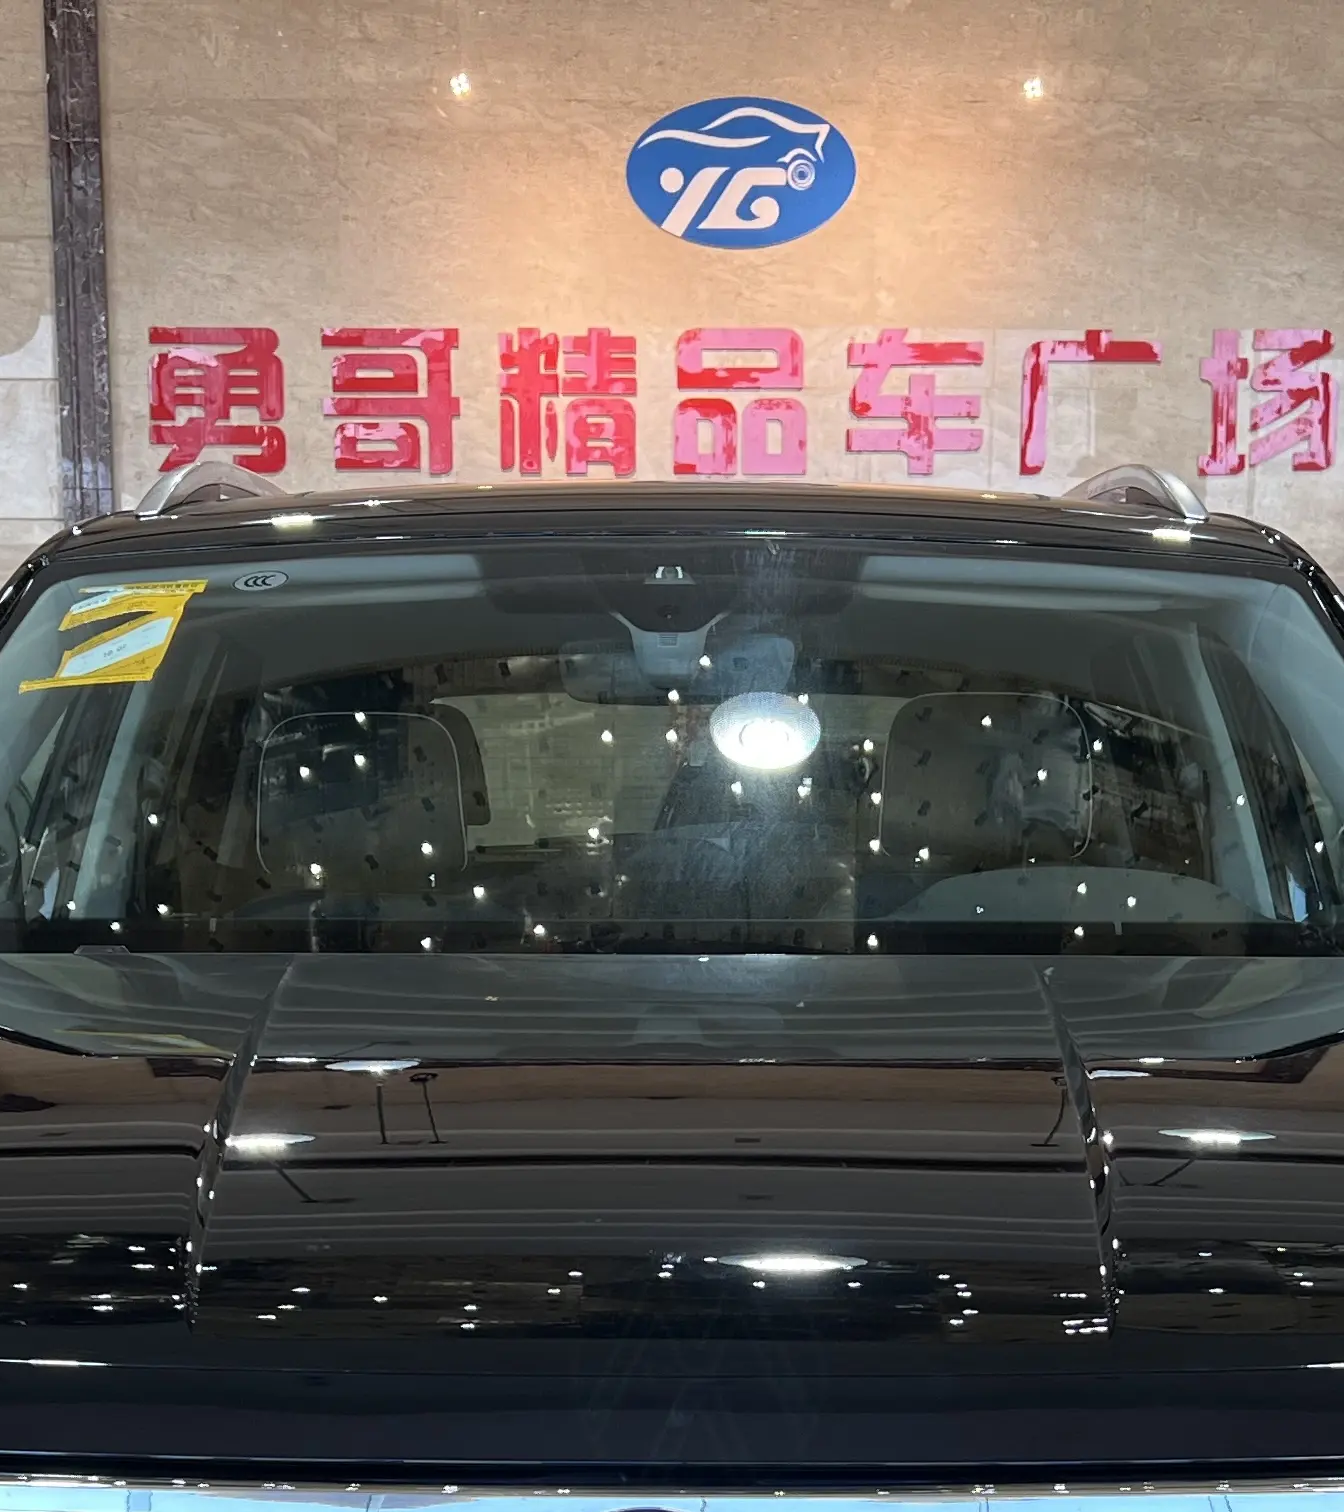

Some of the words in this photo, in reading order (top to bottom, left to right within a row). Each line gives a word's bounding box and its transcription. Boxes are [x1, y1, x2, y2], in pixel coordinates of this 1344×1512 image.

[148, 326, 1337, 477] 勇哥精品车广场
